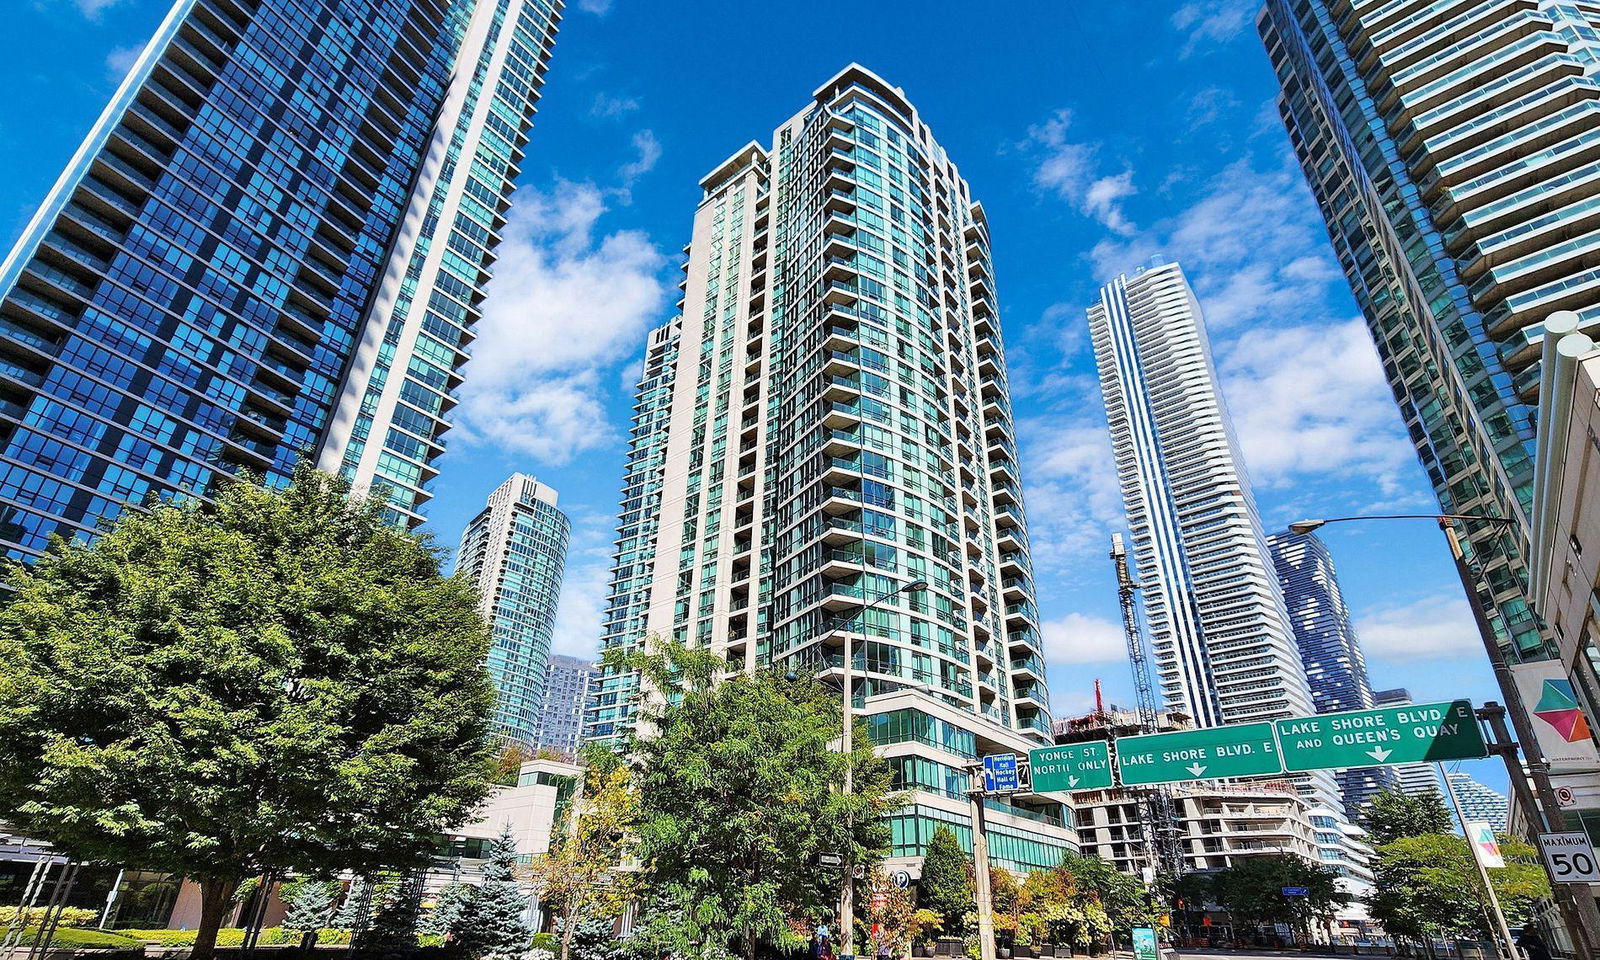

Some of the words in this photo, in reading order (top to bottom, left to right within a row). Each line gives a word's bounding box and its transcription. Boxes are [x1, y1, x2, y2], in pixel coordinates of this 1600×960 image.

[1281, 721, 1321, 736] LAKE
[1331, 715, 1386, 730] SHORE
[1397, 708, 1446, 724] BLVD.
[1456, 706, 1468, 718] E
[1296, 738, 1322, 749] AND
[1332, 728, 1400, 746] QUEEN'S
[1413, 723, 1459, 739] QUAY
[1039, 750, 1074, 762] YONGE
[1083, 747, 1099, 757] ST.
[1122, 753, 1154, 766] LAKE
[1163, 748, 1207, 762] SHORE
[1216, 743, 1255, 757] BLVD.
[1263, 742, 1273, 753] E
[995, 768, 1015, 776] Hockey
[1034, 763, 1070, 775] NORTH
[1078, 759, 1106, 771] ONLY
[1542, 837, 1587, 847] MAXIMUM
[1551, 853, 1594, 876] 50
